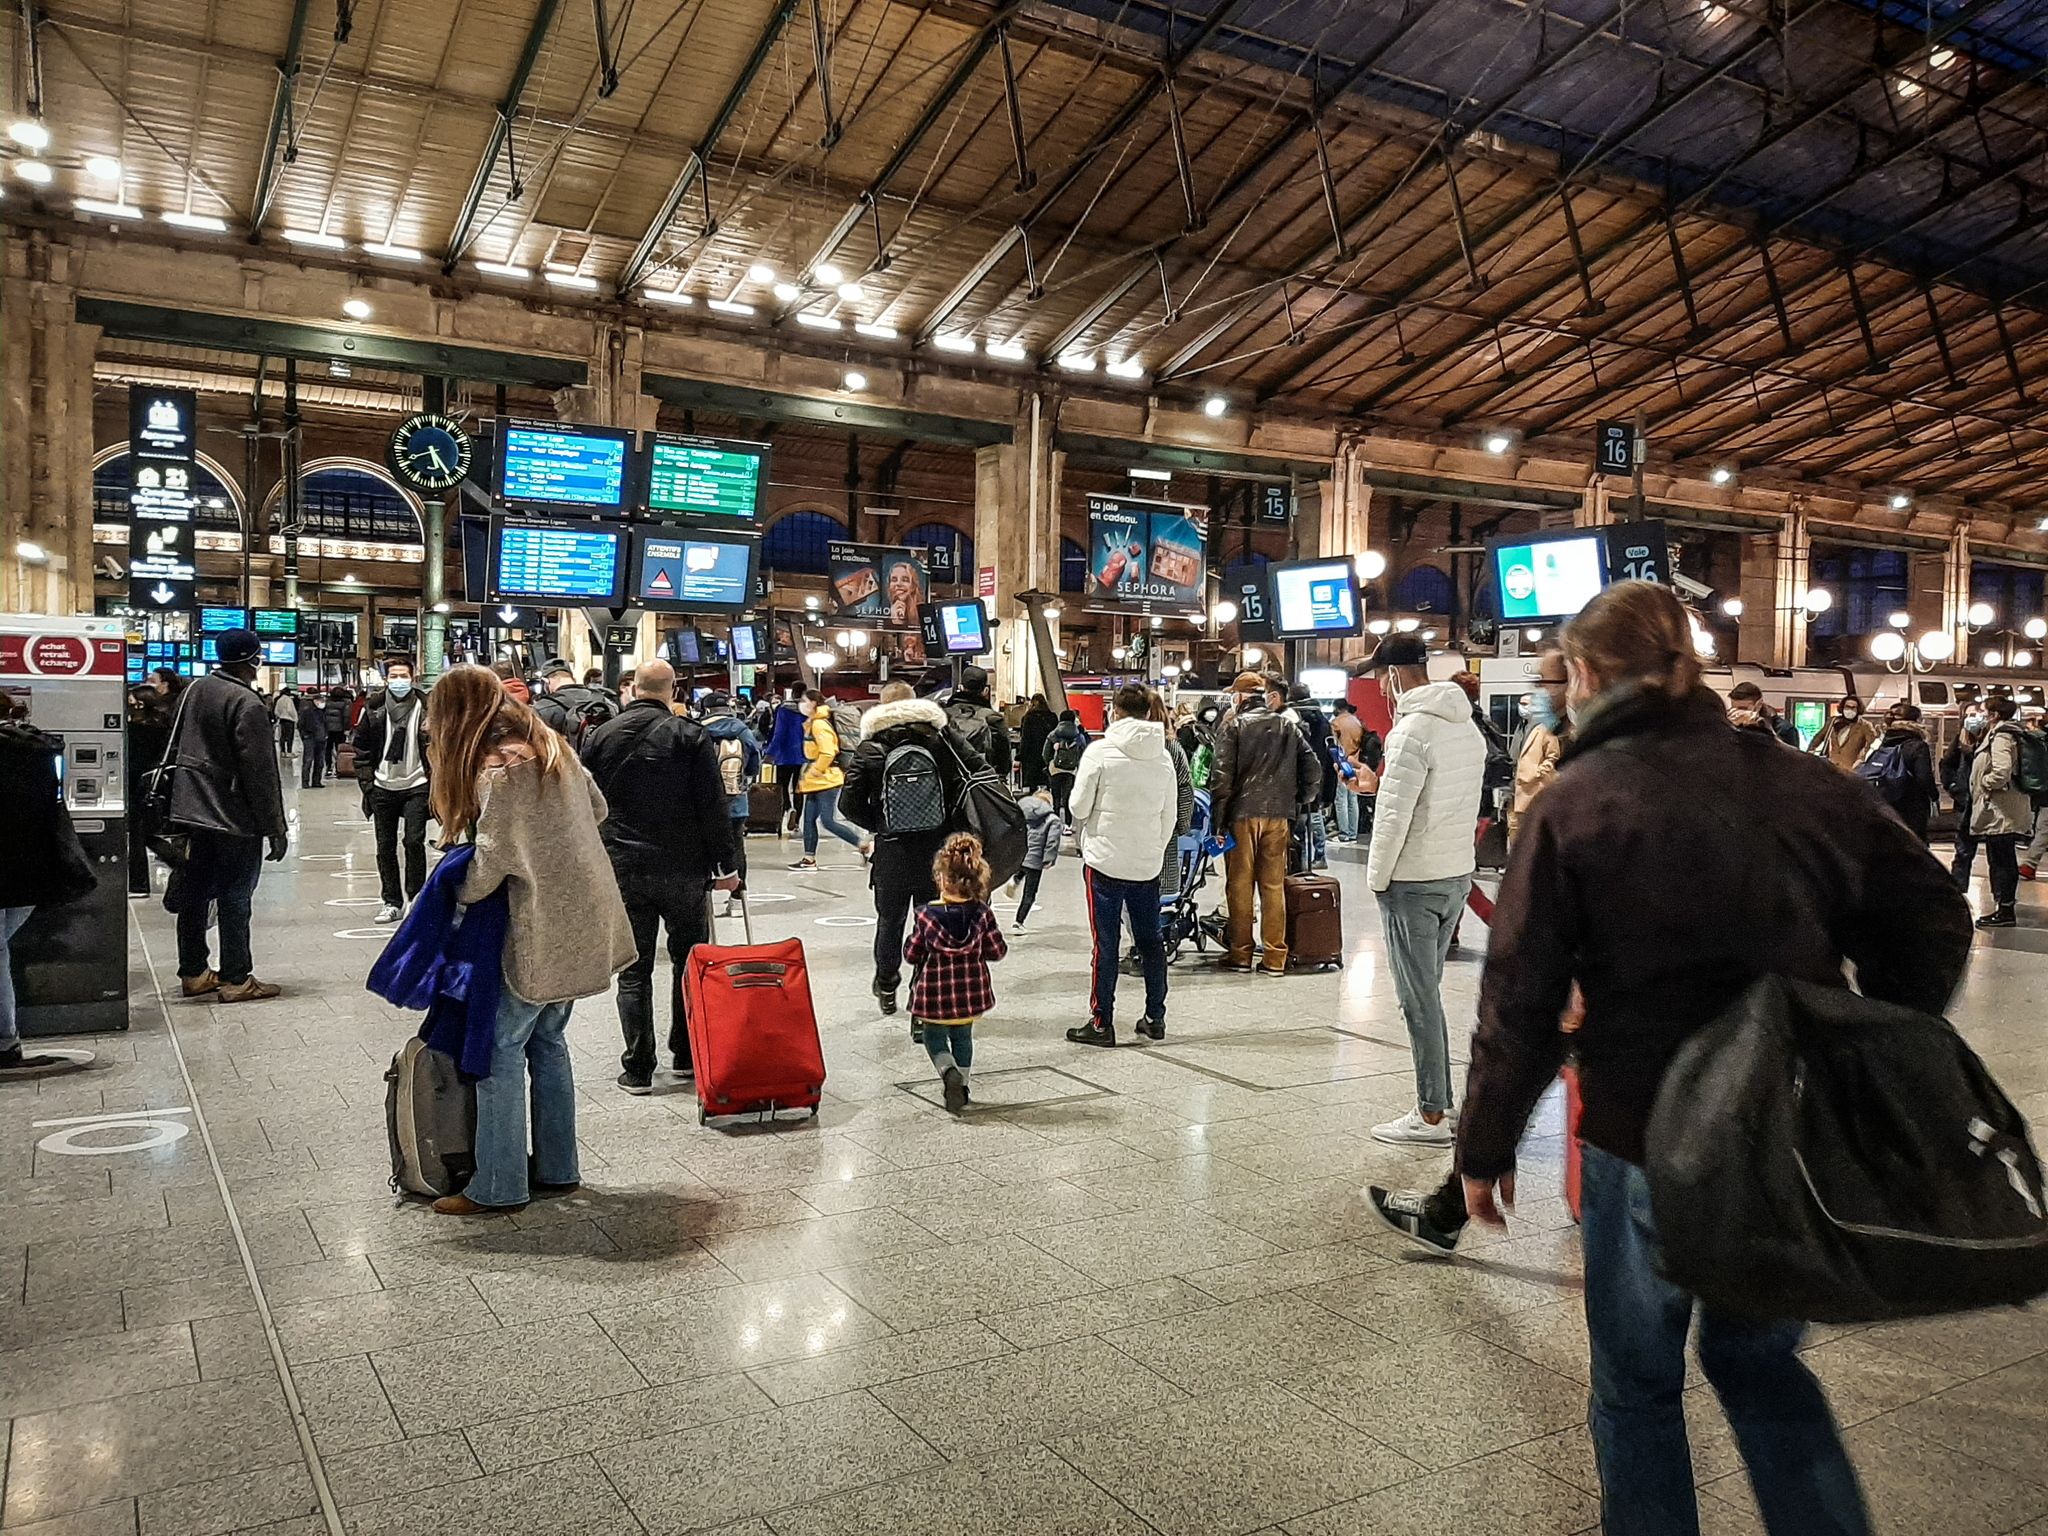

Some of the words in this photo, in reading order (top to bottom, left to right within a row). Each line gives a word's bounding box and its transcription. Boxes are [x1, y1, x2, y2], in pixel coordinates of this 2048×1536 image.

[1604, 439, 1627, 463] 16
[1090, 500, 1100, 509] La
[1102, 501, 1118, 512] joie
[1264, 497, 1284, 516] 15
[1090, 512, 1101, 520] en
[1103, 512, 1138, 524] cadeau.
[933, 552, 949, 566] 14
[1117, 581, 1176, 596] SEPHORA
[1241, 595, 1263, 618] 15
[924, 624, 937, 641] 14
[40, 651, 71, 659] retrait
[40, 659, 79, 669] échange
